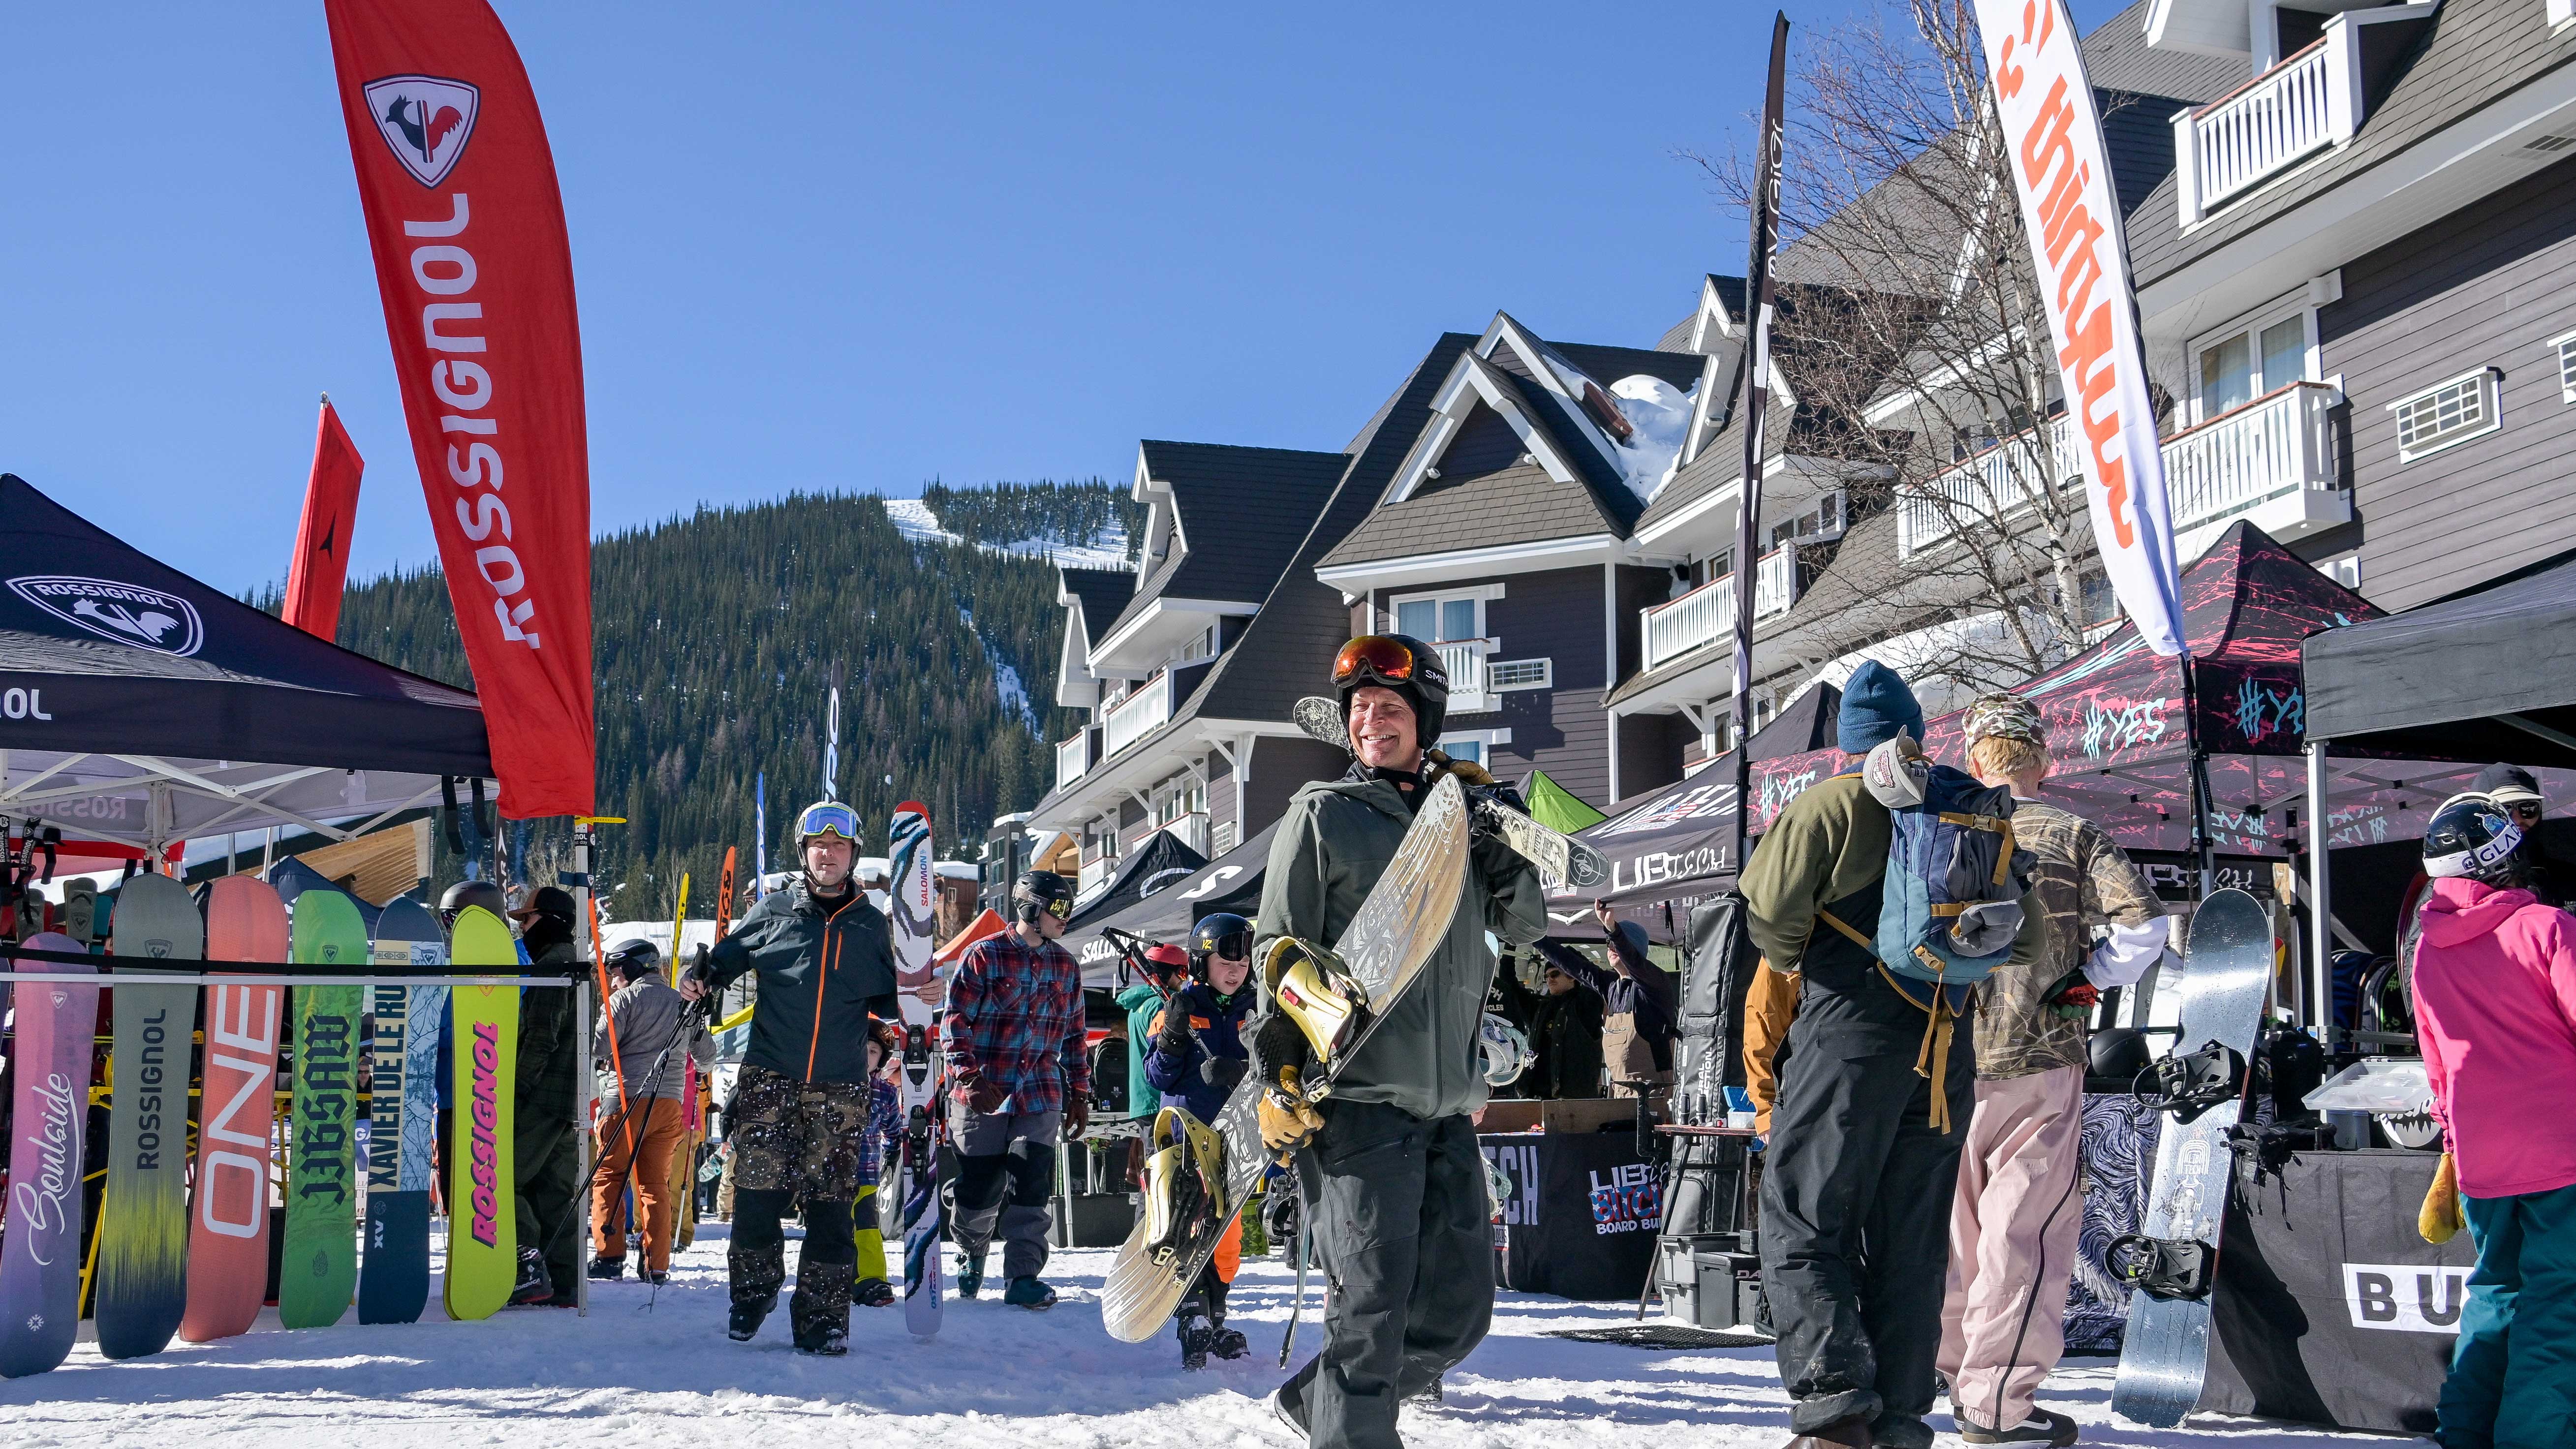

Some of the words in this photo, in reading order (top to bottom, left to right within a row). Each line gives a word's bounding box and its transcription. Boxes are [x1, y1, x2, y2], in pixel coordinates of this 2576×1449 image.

[404, 192, 540, 649] ROSSIGNOL
[34, 584, 174, 609] ROSSIGNOL
[1426, 670, 1448, 688] SMITH
[2081, 697, 2167, 762] #YES
[374, 985, 407, 1019] RU
[374, 1023, 405, 1053] LE
[137, 1008, 166, 1171] ROSSIGNOL
[372, 1058, 403, 1091] DE
[202, 985, 276, 1239] ONE
[471, 1019, 499, 1249] ROSSIGNOL
[368, 1096, 401, 1188] XAVIER
[15, 1073, 80, 1266] Soulside
[373, 1220, 384, 1249] XV
[1596, 1220, 1638, 1234] BOARD
[2356, 1272, 2463, 1326] BU
